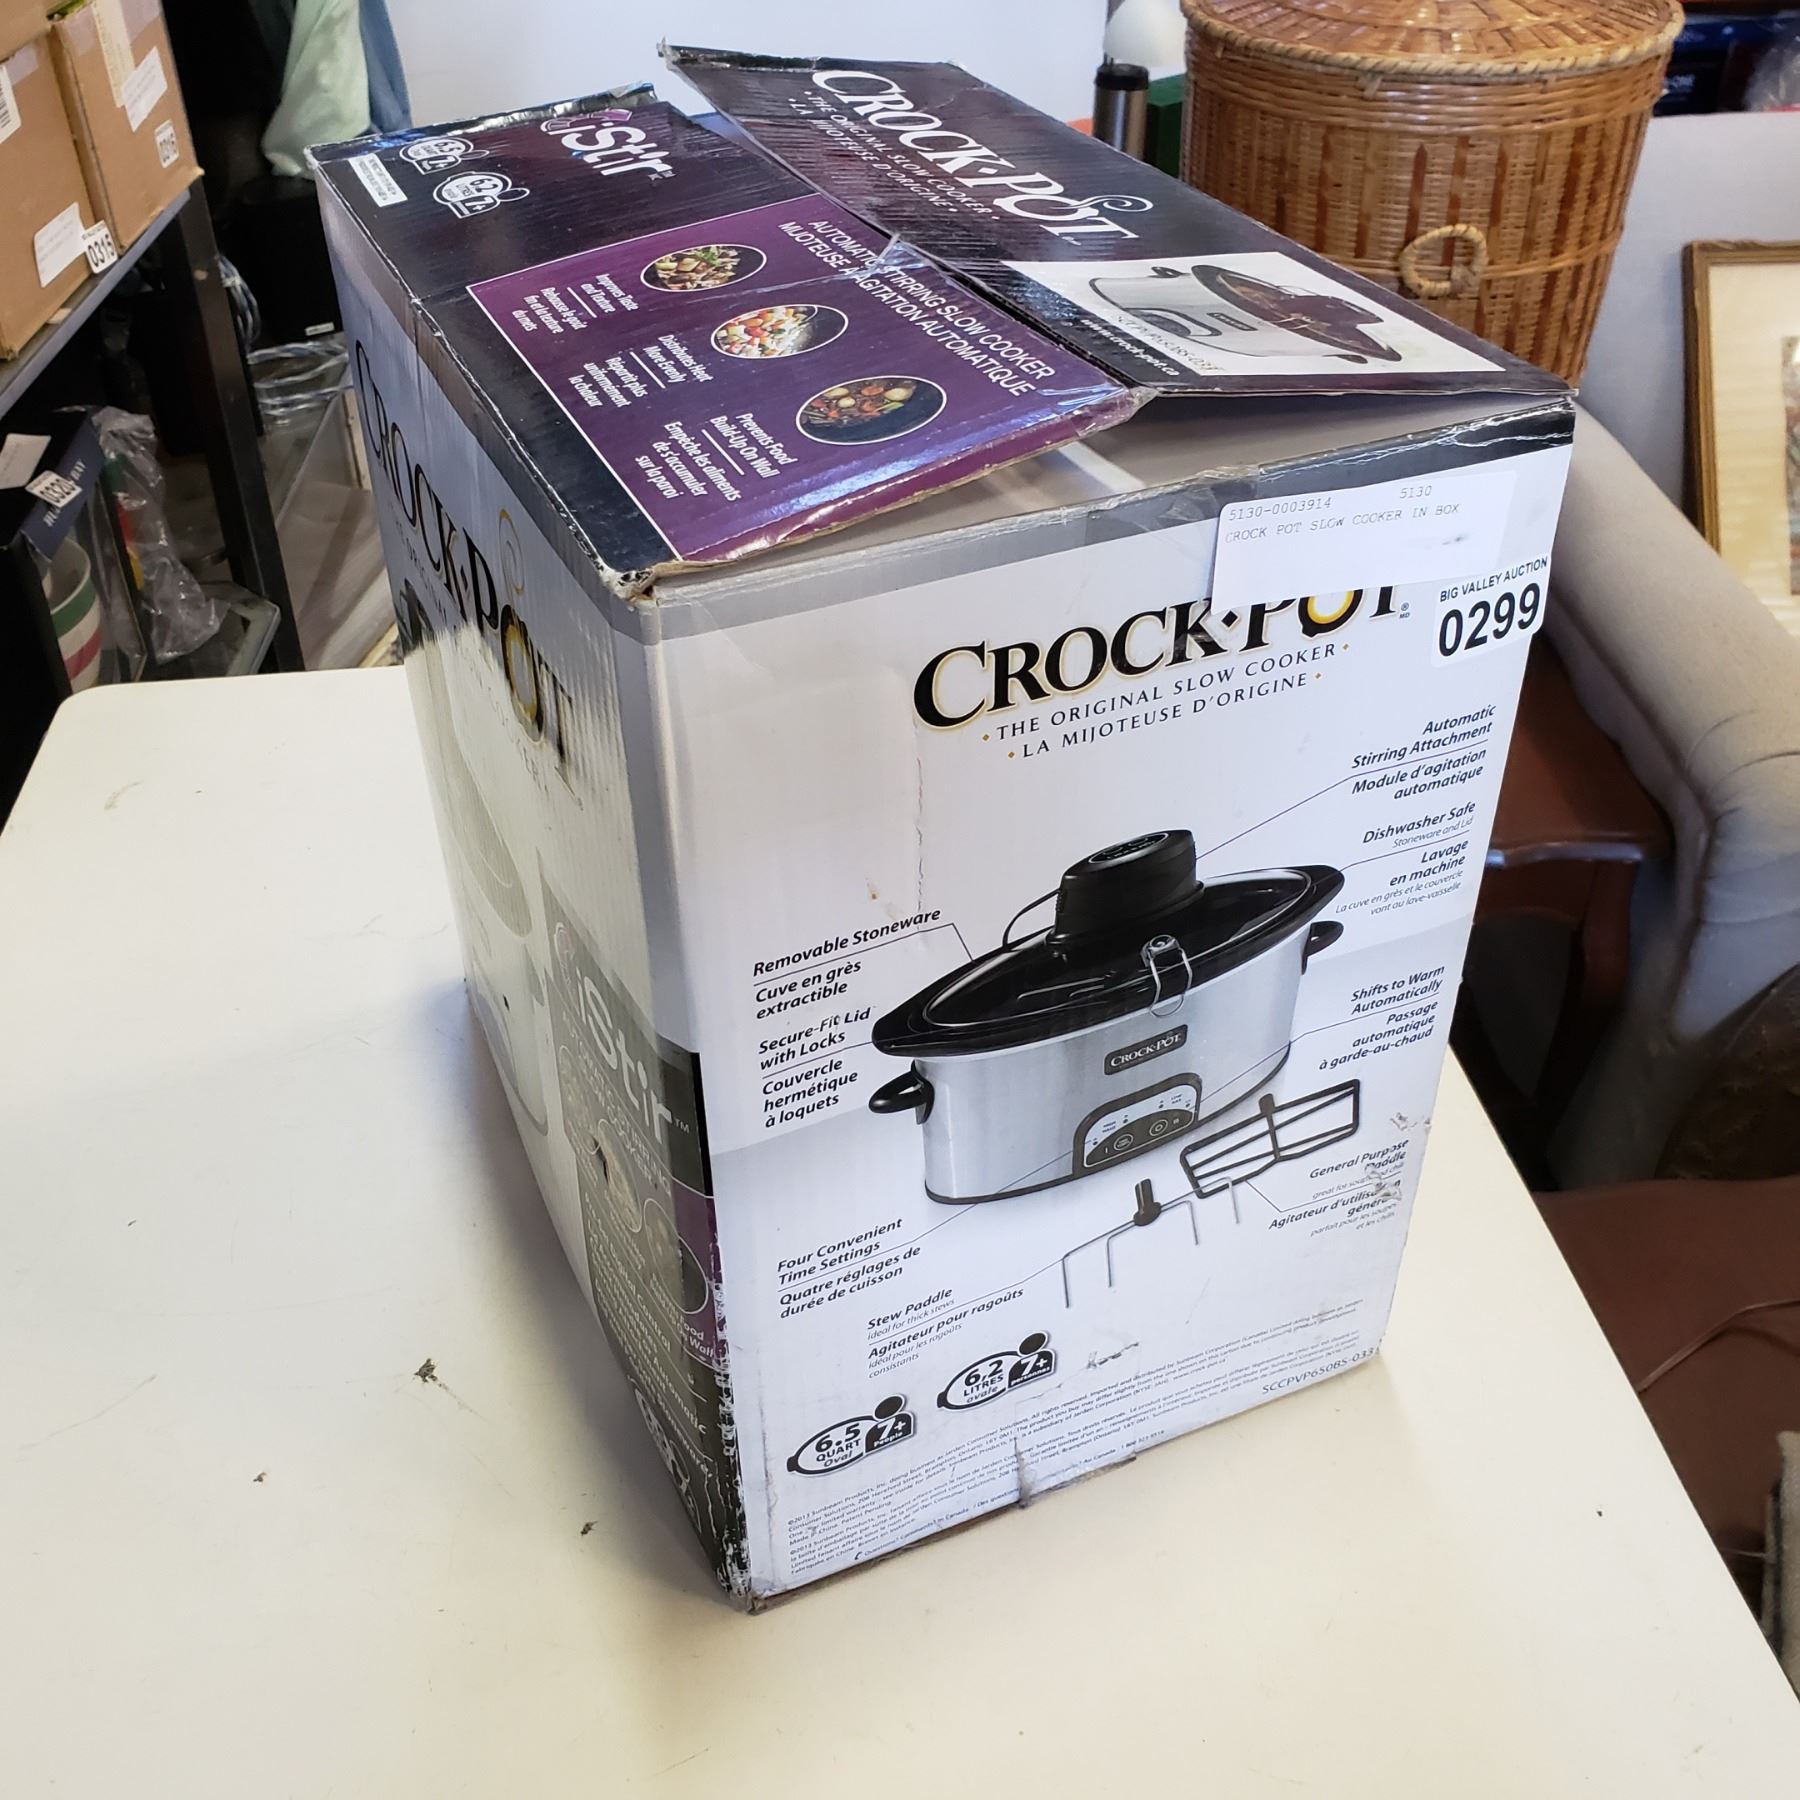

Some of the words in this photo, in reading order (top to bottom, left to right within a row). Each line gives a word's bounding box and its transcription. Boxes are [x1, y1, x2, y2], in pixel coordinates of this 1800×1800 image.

[791, 102, 812, 116] LA
[547, 121, 672, 176] iStir
[809, 95, 831, 114] THE
[831, 113, 887, 160] ORIGINAL
[887, 154, 929, 181] SLOW
[927, 178, 994, 215] COOKER
[540, 287, 569, 312] Rehausse
[581, 283, 602, 294] and
[590, 291, 615, 312] Texture
[595, 273, 625, 297] Improves
[618, 294, 638, 310] Taste
[518, 317, 537, 331] mets
[539, 313, 563, 333] texture
[778, 221, 851, 268] MIJOTEUSE
[849, 271, 929, 321] AGITATION
[915, 320, 1036, 396] AUTOMATIQUE
[658, 334, 696, 367] Distributes
[688, 364, 713, 382] Heat
[936, 305, 990, 335] SLOW
[979, 334, 1055, 379] COOKER
[568, 374, 584, 384] la
[643, 345, 666, 363] More
[657, 360, 687, 382] Evenly
[574, 382, 602, 407] chaleur
[623, 379, 648, 397] plus
[652, 441, 671, 453] de
[664, 421, 701, 456] Empêche
[710, 415, 747, 448] Build-Up
[739, 446, 758, 460] On
[750, 457, 780, 477] Wall
[735, 413, 774, 445] Prevents
[764, 442, 798, 465] Food
[635, 455, 655, 468] sur
[645, 466, 662, 477] la
[692, 453, 710, 465] les
[647, 475, 684, 498] paroi
[699, 461, 741, 501] aliments
[1229, 496, 1332, 521] 5130-0003914
[1400, 485, 1432, 499] 5130
[1225, 525, 1268, 543] CROCK
[1277, 521, 1302, 536] POT
[1310, 517, 1344, 531] SLOW
[1352, 509, 1402, 526] COOKER
[1413, 507, 1428, 519] IN
[1435, 503, 1461, 515] BOX
[1439, 588, 1460, 603] BIG
[1461, 572, 1503, 596] VALLEY
[1503, 556, 1548, 583] AUCTION
[1438, 581, 1541, 658] 0299
[997, 716, 1041, 741] THE
[1050, 686, 1163, 728] ORIGINAL
[1173, 667, 1235, 695] SLOW
[1244, 642, 1337, 677] COOKER
[1023, 738, 1051, 758] LA
[1062, 704, 1183, 748] MIJOTEUSE
[1192, 672, 1308, 714] D'ORIGINE
[1422, 704, 1497, 735] Automatic
[1352, 746, 1408, 769] Stirring
[1409, 722, 1493, 755] Attachment
[1352, 770, 1409, 794] Module
[1410, 749, 1487, 780] d'agitation
[1394, 765, 1484, 800] automatique
[1362, 812, 1446, 844] Dishwasher
[1448, 801, 1476, 821] Safe
[1392, 828, 1442, 849] Stoneware
[1442, 823, 1459, 835] and
[1460, 816, 1474, 828] Lid
[1421, 839, 1469, 864] Lavage
[1389, 875, 1407, 886] en
[1409, 855, 1466, 881] machine
[1348, 898, 1370, 910] cuve
[1384, 887, 1403, 902] grès
[1424, 869, 1464, 889] couvercle
[1371, 903, 1391, 915] vont
[753, 936, 849, 977] Removable
[852, 909, 942, 946] Stoneware
[755, 981, 798, 1003] Cuve
[801, 974, 822, 989] en
[826, 960, 862, 985] grès
[1351, 982, 1389, 1002] Shifts
[1391, 980, 1405, 989] to
[1408, 966, 1445, 985] Warm
[1351, 979, 1443, 1015] Automatically
[756, 981, 848, 1020] extractible
[1386, 1001, 1439, 1025] Passage
[758, 1013, 841, 1054] Secure-Fit
[844, 1007, 871, 1025] Lid
[1319, 1060, 1327, 1070] à
[1329, 1025, 1434, 1069] garde-au-chaud
[1352, 1015, 1436, 1048] automatique
[760, 1049, 796, 1071] with
[799, 1030, 846, 1057] Locks
[762, 1059, 843, 1095] Couvercle
[763, 1071, 859, 1113] hermétique
[765, 1114, 776, 1129] à
[779, 1093, 840, 1125] loquets
[1309, 1155, 1360, 1179] General
[1269, 1204, 1329, 1230] Agitateur
[777, 1251, 815, 1273] Four
[817, 1218, 903, 1259] Convenient
[778, 1262, 818, 1286] Time
[819, 1241, 881, 1273] Settings
[779, 1278, 835, 1306] Quatre
[836, 1255, 902, 1288] réglages
[903, 1245, 922, 1260] de
[780, 1295, 825, 1320] durée
[827, 1286, 847, 1301] de
[849, 1266, 904, 1292] cuisson
[866, 1310, 904, 1330] Stew
[904, 1287, 954, 1316] Paddle
[867, 1325, 892, 1341] ideal
[906, 1308, 930, 1329] thick
[930, 1299, 955, 1316] stews
[868, 1324, 936, 1359] Agitateur
[936, 1308, 970, 1334] pour
[970, 1287, 1025, 1317] ragoûts
[869, 1352, 891, 1369] idéal
[891, 1344, 916, 1362] pour
[929, 1323, 963, 1347] ragoûts
[869, 1351, 920, 1379] consistants
[964, 1358, 1005, 1387] 6,2
[1018, 1354, 1049, 1378] 7+
[962, 1373, 1005, 1397] LITRES
[966, 1384, 999, 1405] ovale
[814, 1423, 862, 1452] 6.5
[873, 1429, 904, 1448] People
[877, 1417, 908, 1440] 7+
[815, 1438, 862, 1462] QUART
[823, 1451, 854, 1468] Oval
